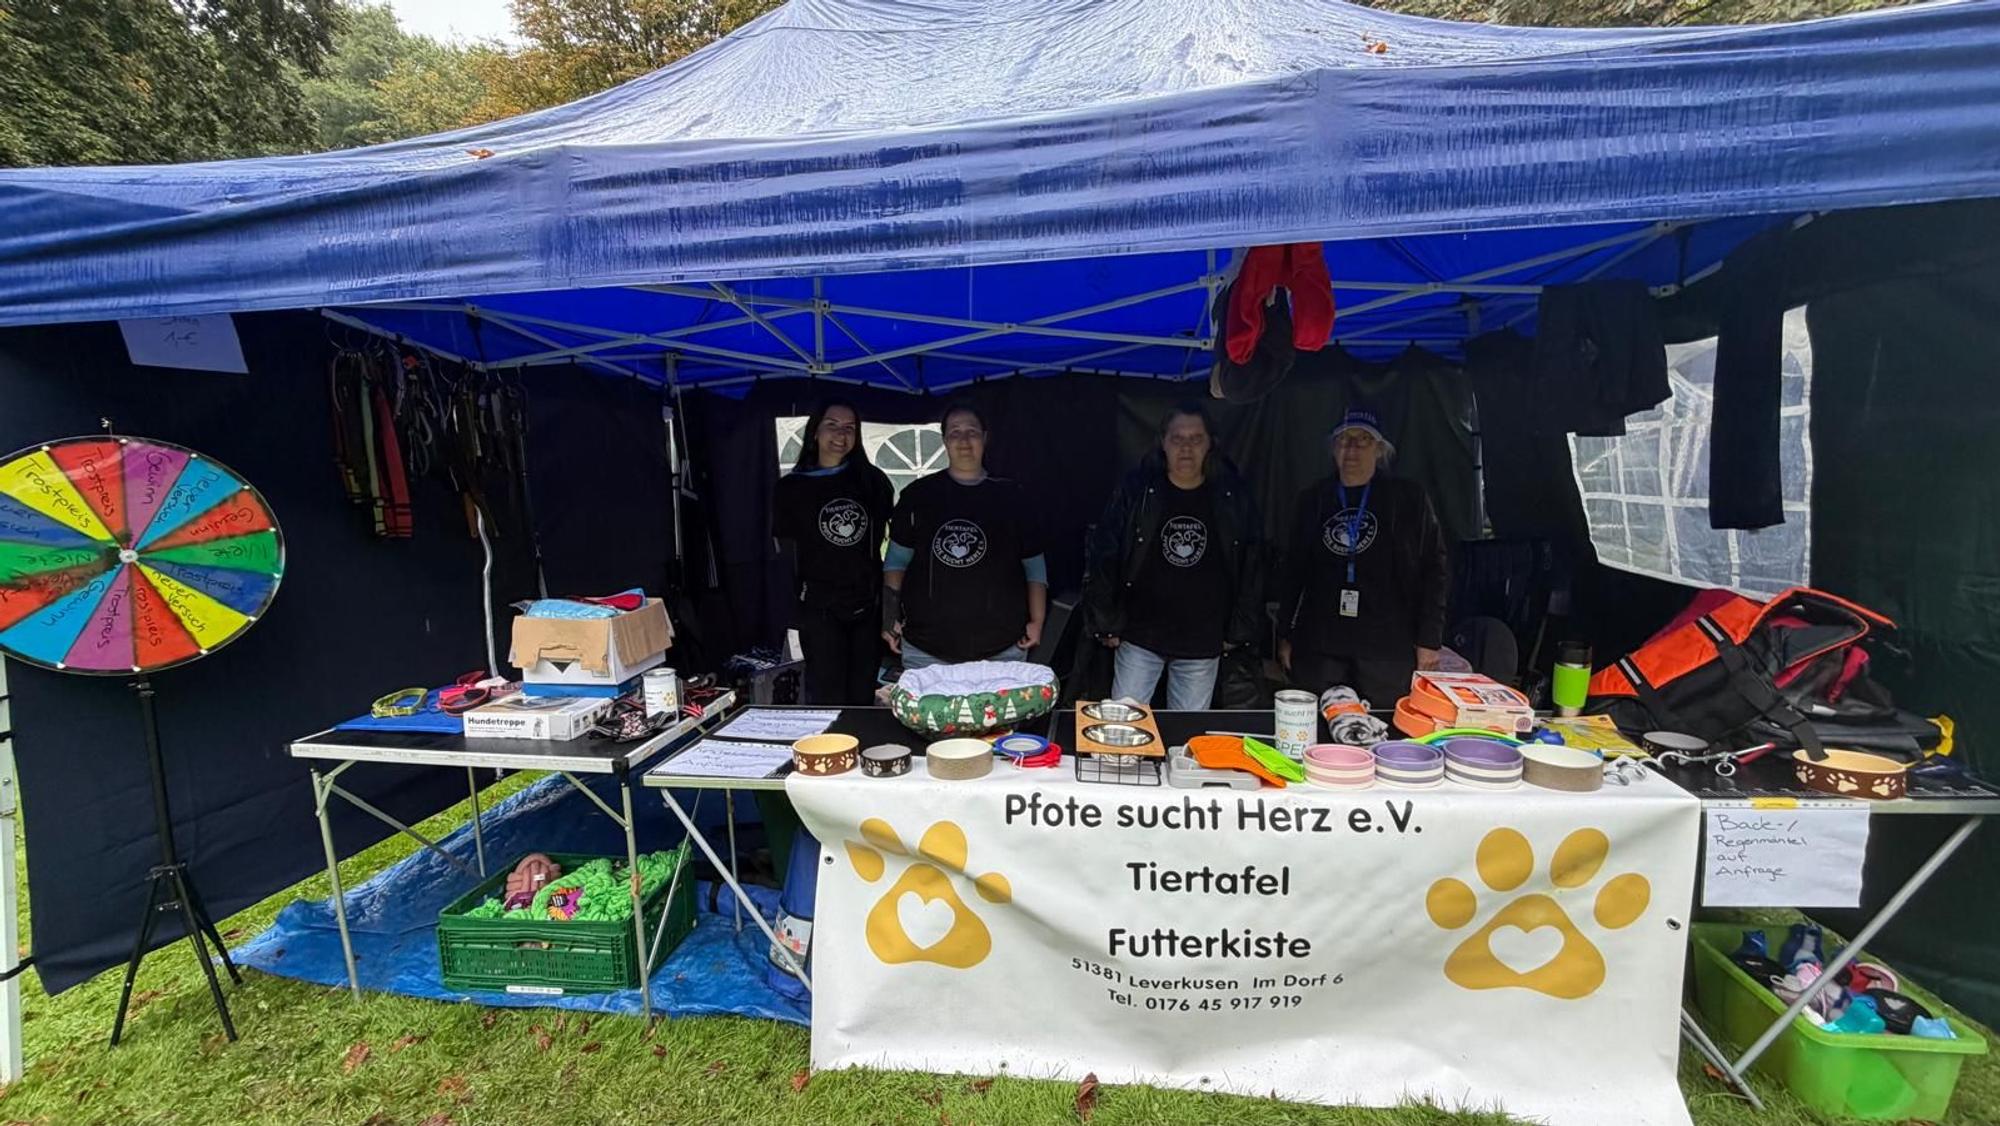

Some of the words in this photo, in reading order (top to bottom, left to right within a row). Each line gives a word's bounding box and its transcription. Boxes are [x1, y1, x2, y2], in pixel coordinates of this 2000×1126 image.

[16, 457, 91, 528] Trostpreis
[467, 717, 526, 727] Hundetreppe
[1005, 793, 1102, 827] Pfote
[1116, 796, 1222, 830] sucht
[1238, 798, 1332, 832] Herz
[1348, 800, 1423, 833] e.V.
[1126, 861, 1290, 895] Tiertafel
[1715, 866, 1788, 881] Anfrage
[1108, 928, 1311, 958] Futterkiste
[1071, 958, 1122, 983] 51381
[1129, 976, 1239, 990] Leverkusen
[1253, 976, 1276, 989] Im
[1283, 973, 1328, 987] Dorf
[1333, 973, 1344, 985] 6
[1107, 988, 1137, 1008] Tel.
[1145, 997, 1191, 1012] 0176
[1198, 998, 1222, 1012] 45
[1230, 996, 1262, 1010] 917
[1270, 995, 1303, 1009] 919
